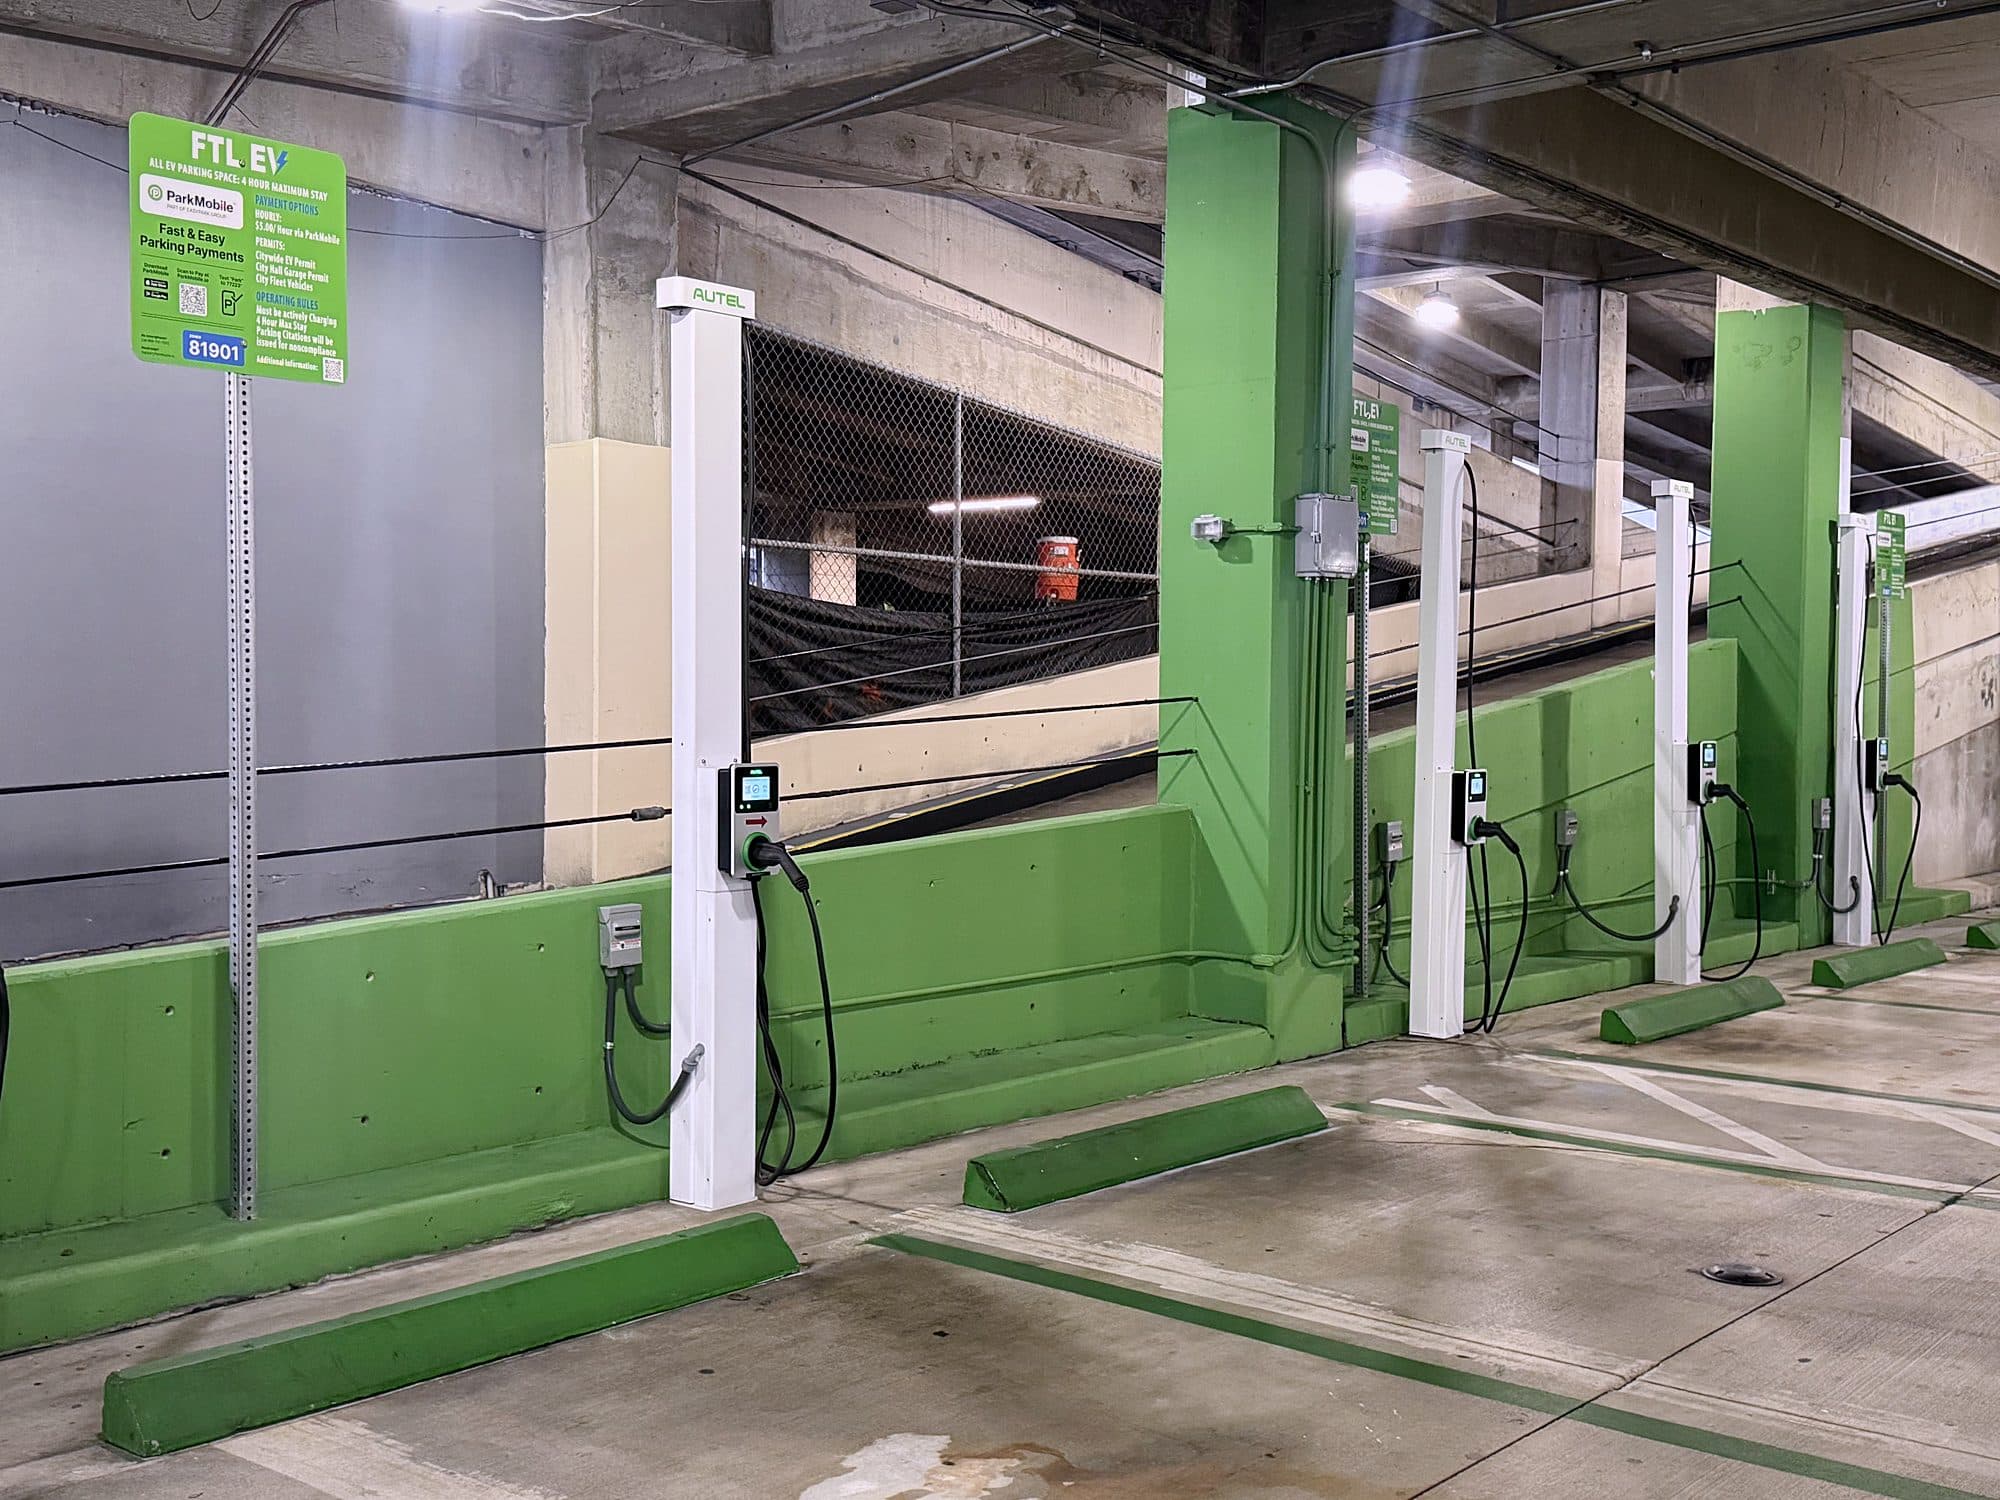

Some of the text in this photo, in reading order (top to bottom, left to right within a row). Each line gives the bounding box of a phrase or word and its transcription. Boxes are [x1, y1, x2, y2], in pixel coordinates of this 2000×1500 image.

[192, 130, 288, 176] FTL EV
[149, 157, 328, 202] ALL EV PARKING SPACE: 4 HOUR MAXIMUM STAY
[167, 190, 234, 213] ParkMobile
[255, 194, 319, 216] PAYMENT OPTIONS
[255, 208, 282, 223] HOURLY:
[160, 223, 226, 247] Fast & Easy
[255, 236, 285, 250] PERMITS:
[277, 225, 293, 237] Hour
[294, 228, 304, 239] via
[305, 229, 340, 245] ParkMobile
[140, 234, 244, 263] Parking Payments
[255, 250, 316, 270] Citywide EV Permit
[255, 261, 329, 283] City Hall Garage Permit
[255, 273, 314, 292] City Fleet Vehicles
[256, 291, 319, 310] OPERATING RULES
[693, 287, 746, 309] AUTEL
[256, 304, 338, 329] Must be actively Charging
[256, 315, 308, 334] 4 Hour Max Stay
[256, 325, 334, 347] Parking Citations will be
[189, 339, 239, 361] 81901
[278, 339, 289, 350] for
[288, 343, 337, 358] noncompliance
[256, 355, 285, 367] Additional
[1445, 435, 1468, 448] AUTEL
